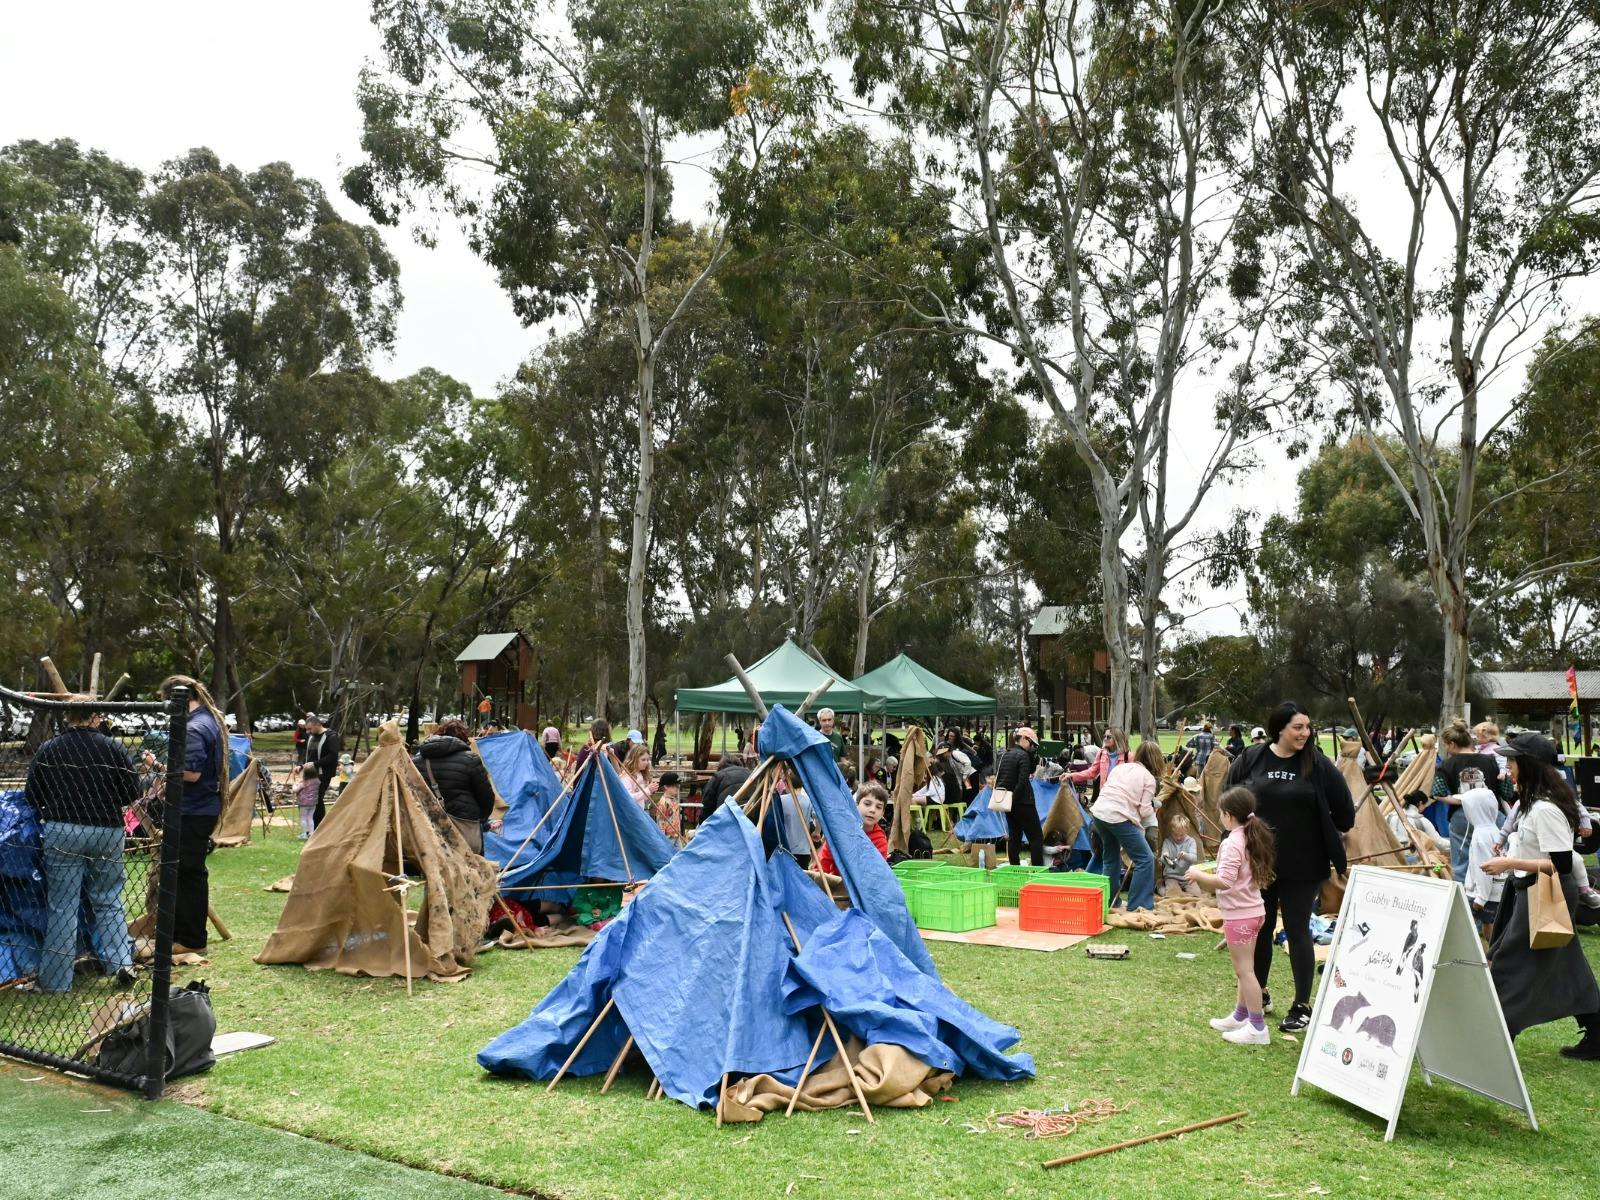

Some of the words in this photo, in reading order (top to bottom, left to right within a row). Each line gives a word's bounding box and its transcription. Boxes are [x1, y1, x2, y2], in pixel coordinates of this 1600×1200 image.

[1267, 771, 1296, 780] ECHT
[1365, 890, 1390, 909] Cubby
[1392, 896, 1427, 918] Building
